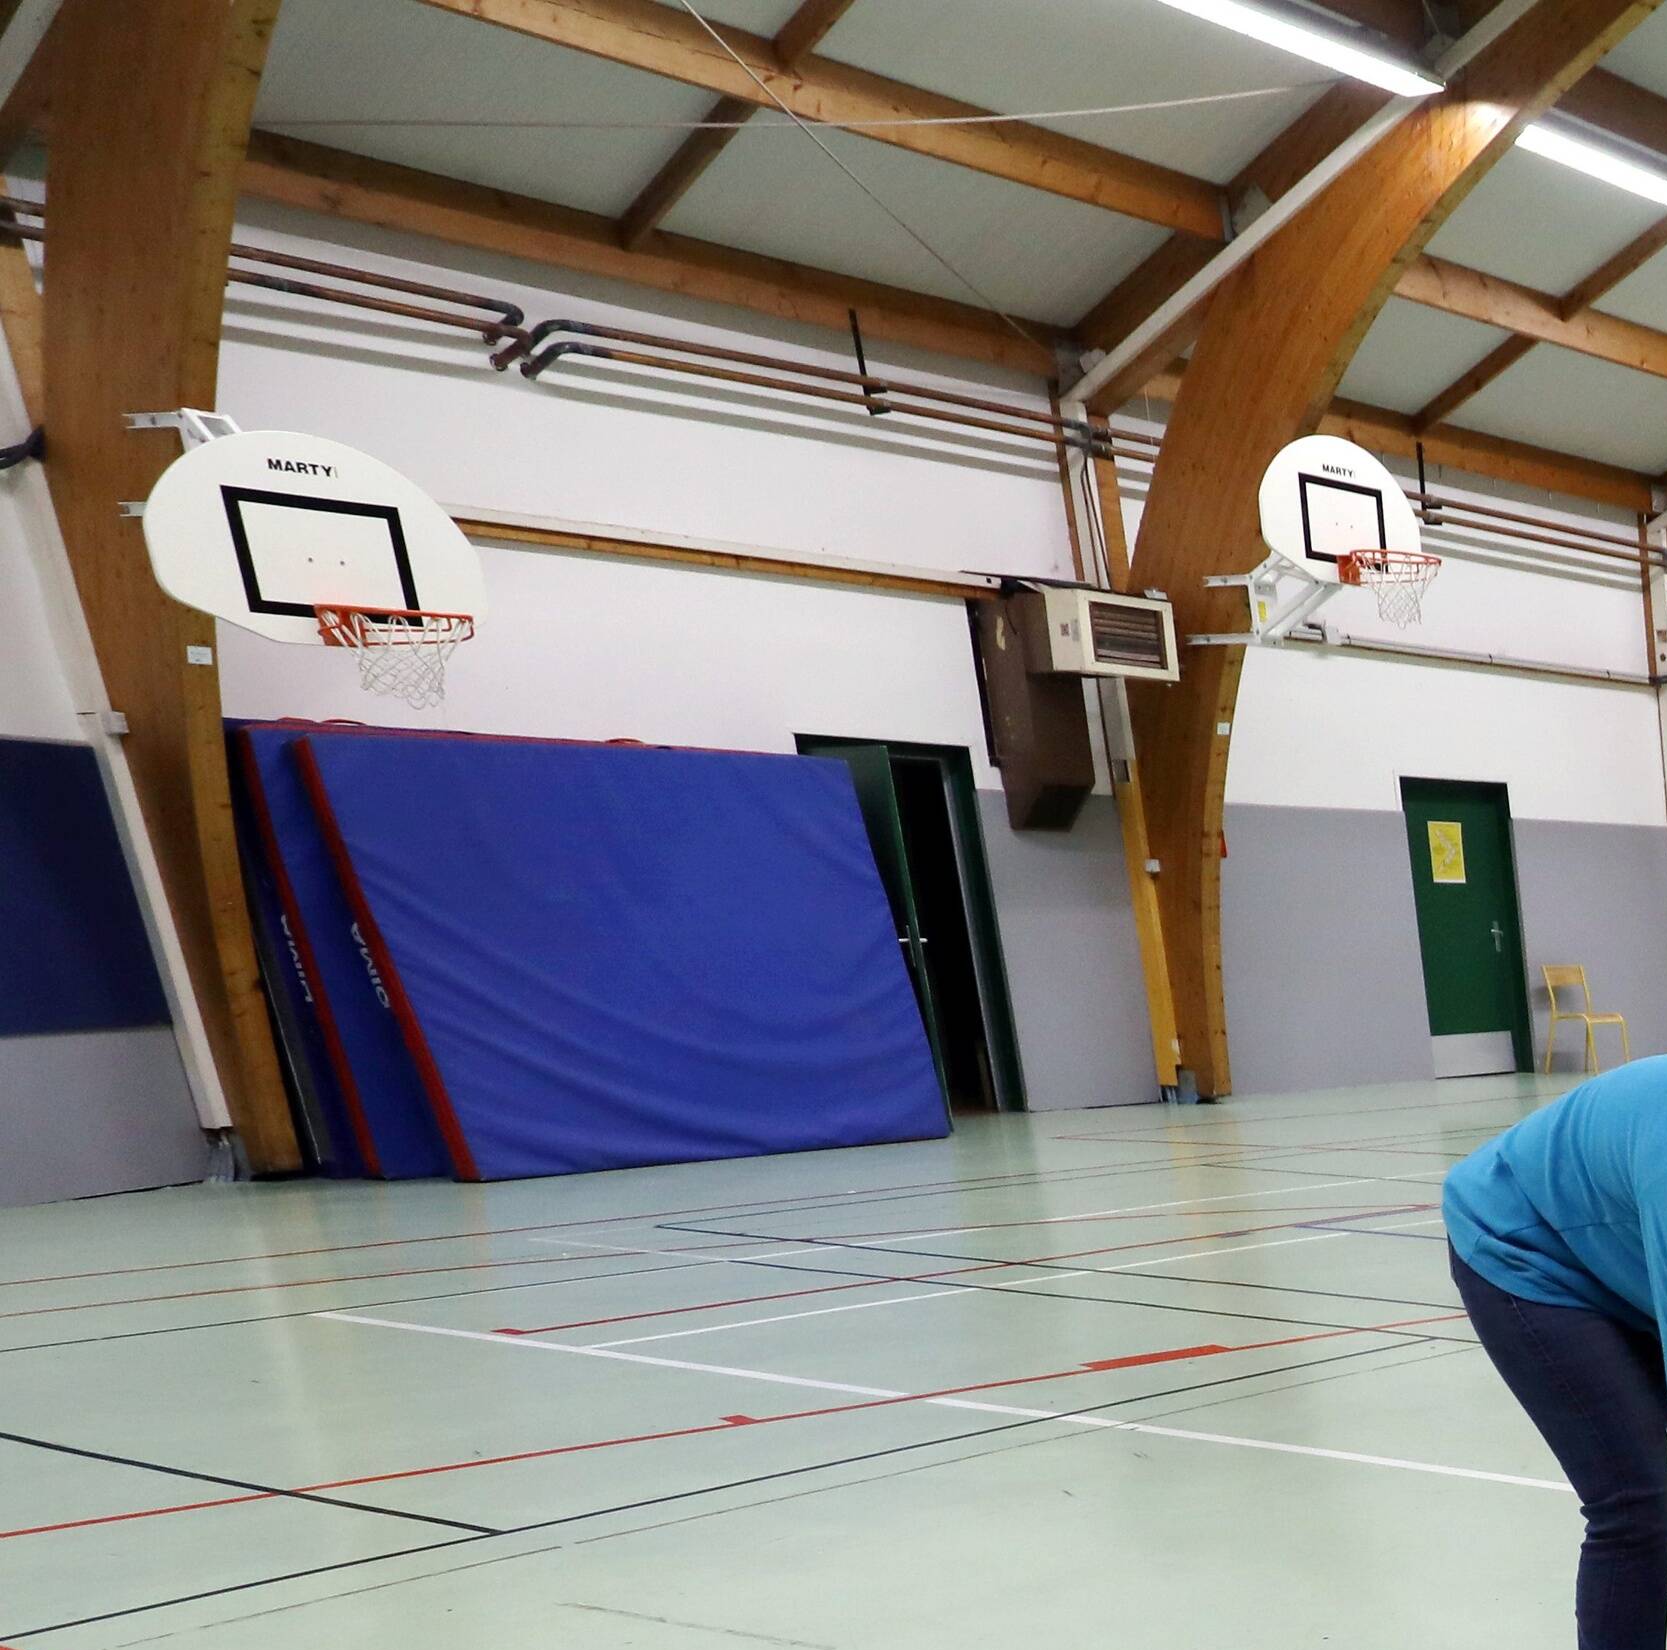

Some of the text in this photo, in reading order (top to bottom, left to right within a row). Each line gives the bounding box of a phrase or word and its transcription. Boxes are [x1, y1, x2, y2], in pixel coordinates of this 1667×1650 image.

[266, 458, 333, 477] MARTY
[1322, 463, 1353, 478] MARTY
[351, 921, 391, 1009] DIMA
